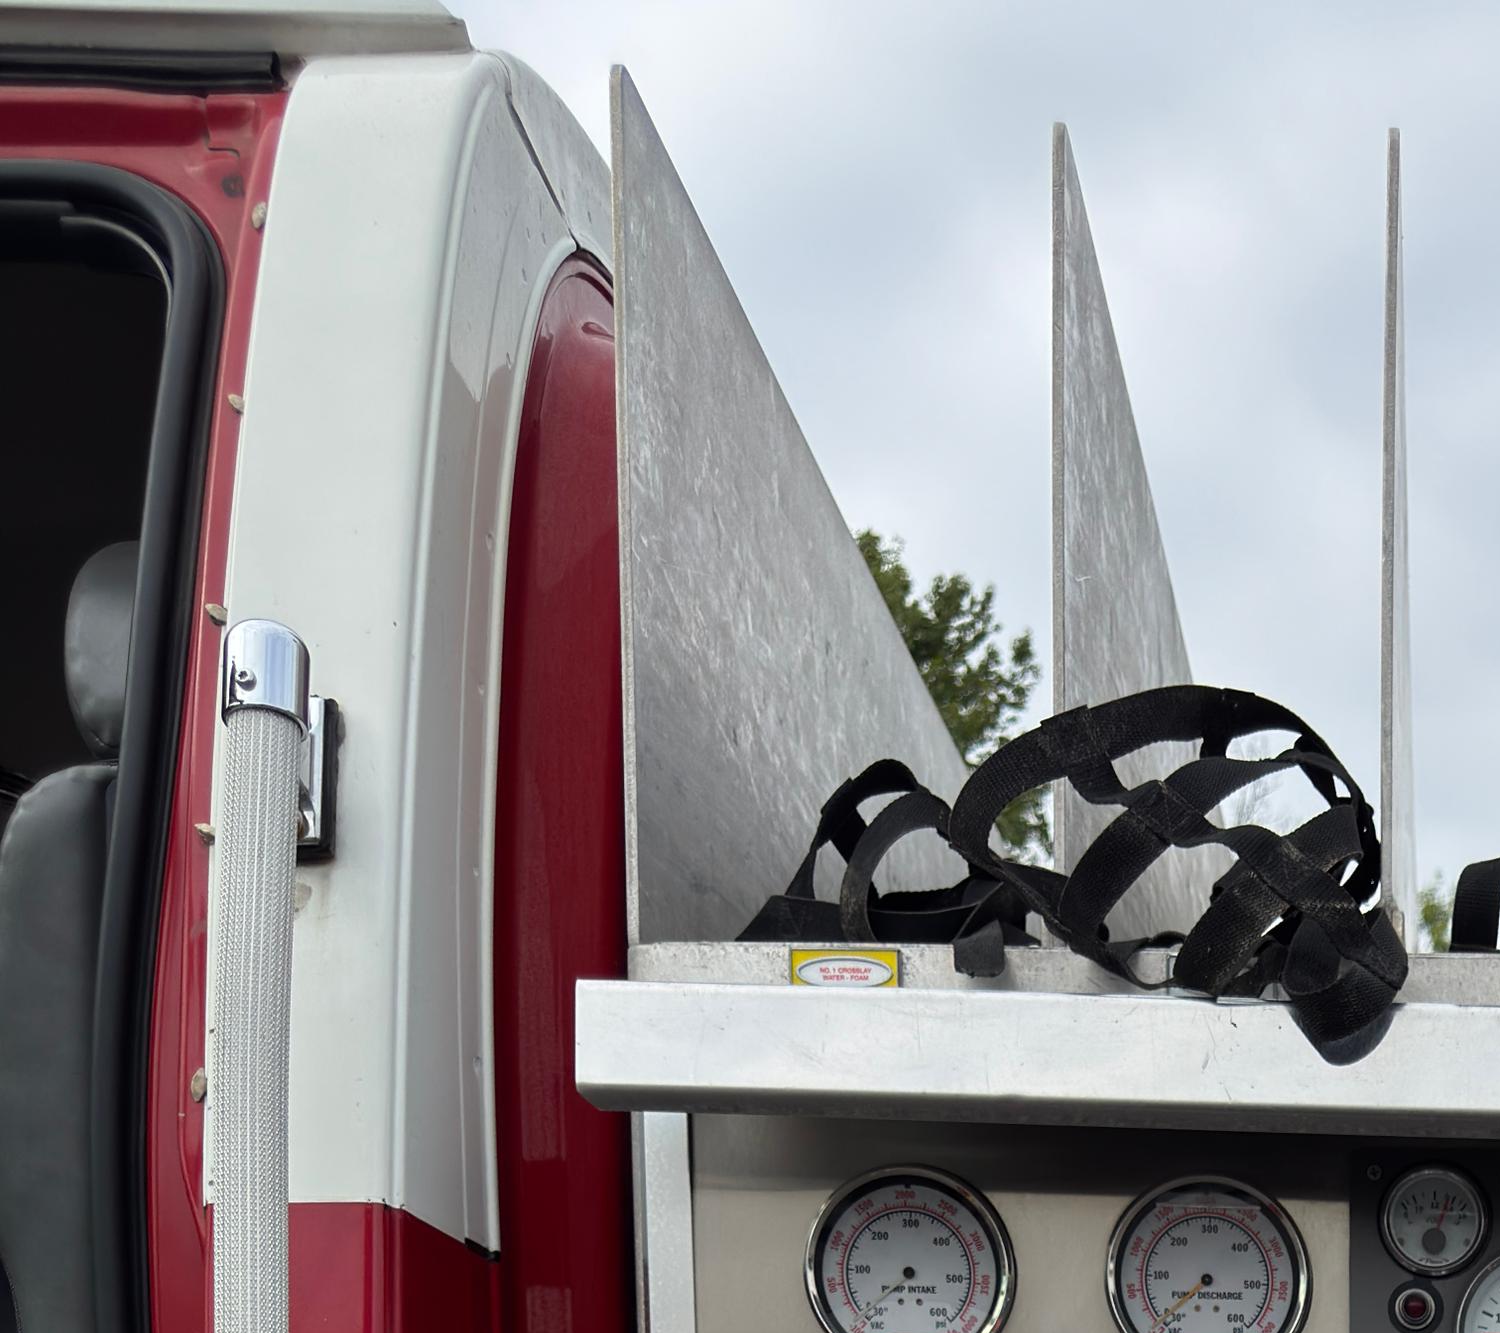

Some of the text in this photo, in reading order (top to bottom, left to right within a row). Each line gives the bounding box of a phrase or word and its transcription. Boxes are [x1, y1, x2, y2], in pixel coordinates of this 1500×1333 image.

[902, 1219, 919, 1228] 300
[933, 1237, 950, 1246] 400
[1232, 1243, 1248, 1252] 400
[946, 1274, 963, 1283] 500
[908, 1286, 936, 1294] INTAKE
[1198, 1292, 1243, 1300] DISCHARGE
[930, 1307, 947, 1317] 600
